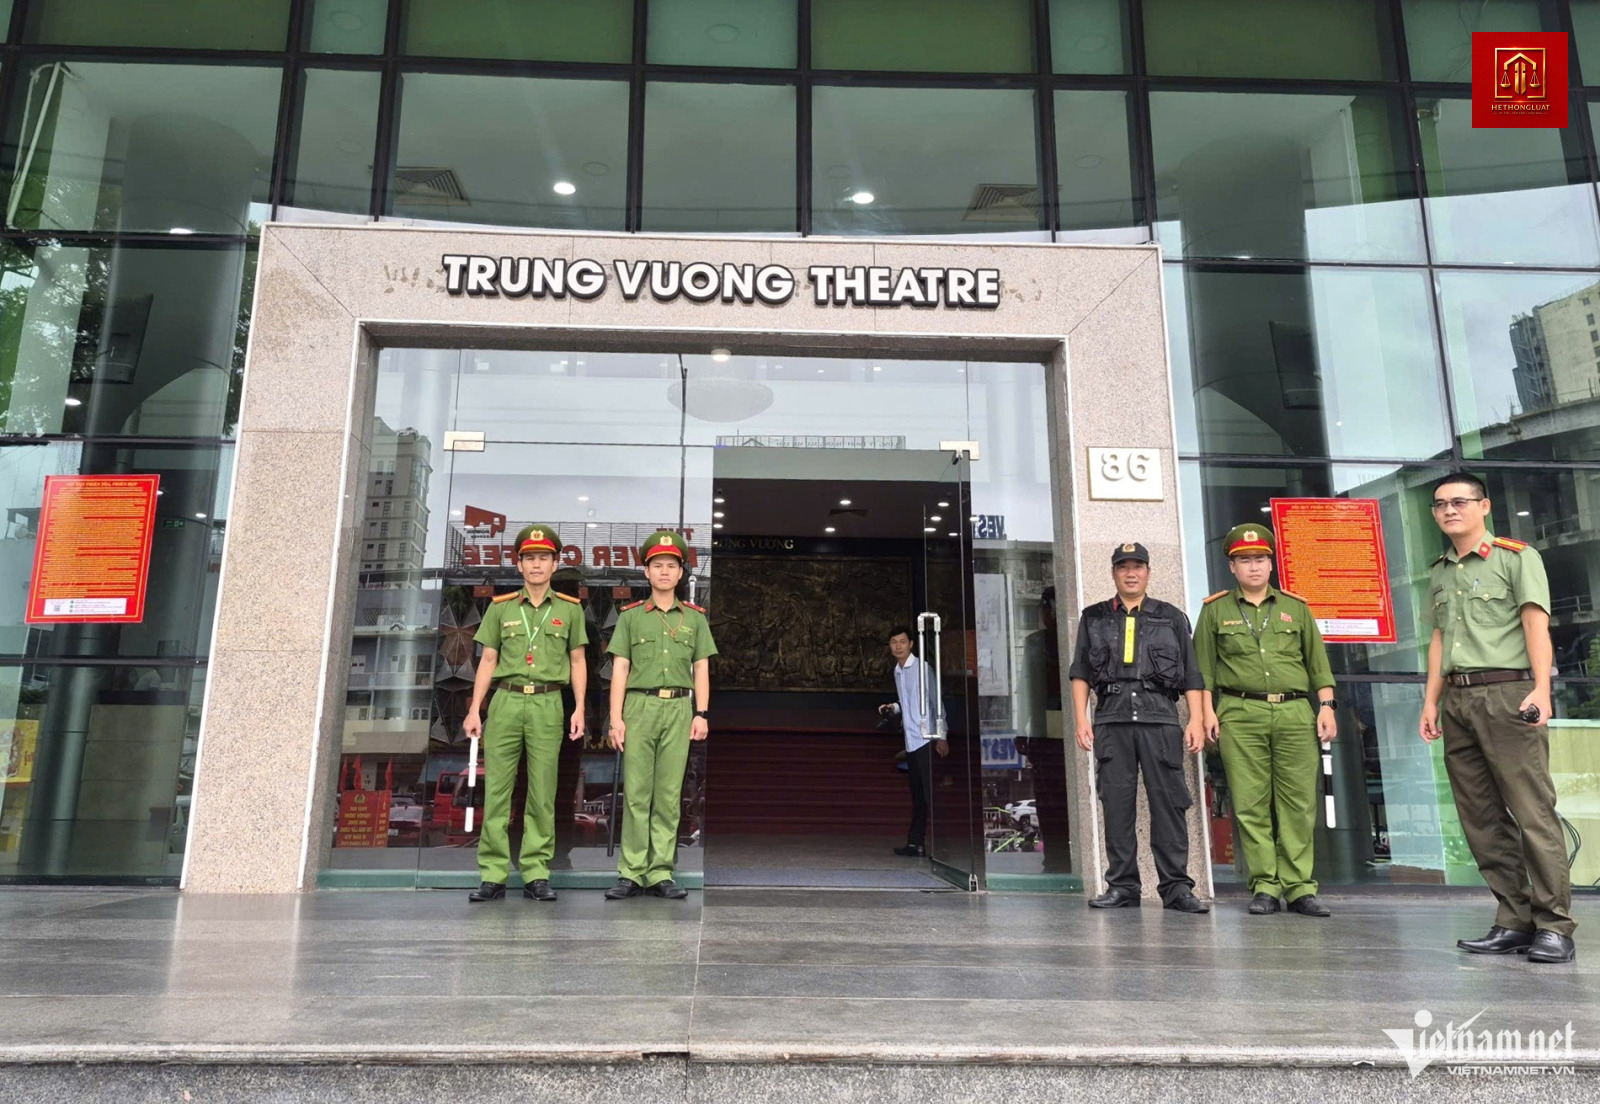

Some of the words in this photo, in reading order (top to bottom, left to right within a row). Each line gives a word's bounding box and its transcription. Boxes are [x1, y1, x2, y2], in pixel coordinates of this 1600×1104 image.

[442, 254, 607, 300] TRUNG
[613, 259, 796, 303] VUONG
[808, 265, 1000, 308] THEATRE
[1101, 453, 1150, 482] 86
